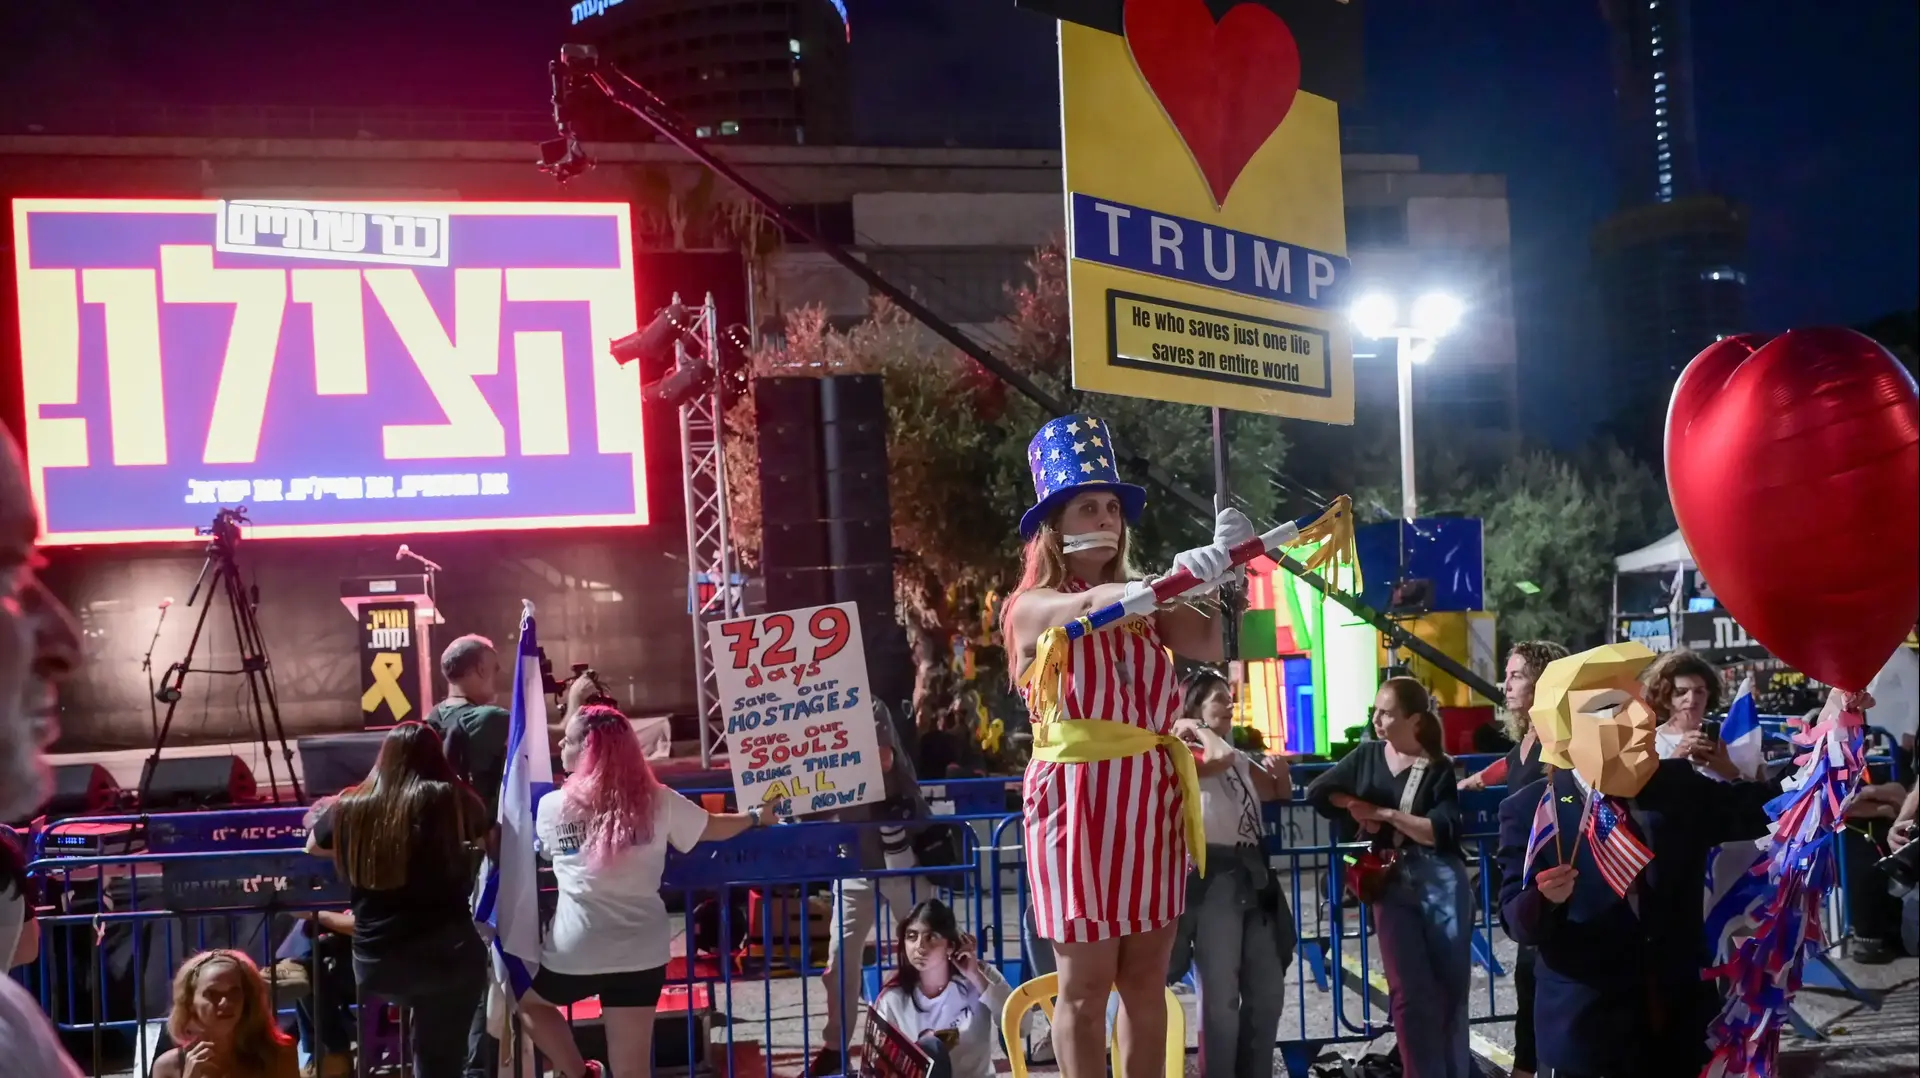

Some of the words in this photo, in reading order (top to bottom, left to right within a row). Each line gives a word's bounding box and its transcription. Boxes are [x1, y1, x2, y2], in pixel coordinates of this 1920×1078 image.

[228, 204, 366, 253] שנתיים
[371, 214, 438, 257] כבר
[1095, 202, 1335, 300] TRUMP
[1132, 306, 1151, 328] He
[1155, 312, 1184, 334] who
[1189, 319, 1230, 342] saves
[1233, 323, 1260, 348] just
[1263, 332, 1287, 352] one
[1291, 334, 1311, 356] life
[25, 244, 642, 467] הצילו!
[1152, 342, 1195, 366] saves
[1199, 350, 1216, 369] an
[1220, 353, 1259, 376] entire
[1262, 361, 1299, 382] world
[721, 607, 850, 669] 729
[745, 660, 821, 689] days
[727, 687, 860, 735] HOSTAGES
[741, 764, 793, 786] BRING
[802, 751, 862, 773] THEM
[748, 730, 849, 769] SOULS
[748, 798, 793, 816] ME
[811, 781, 867, 811] NOW!
[762, 770, 836, 802] ALL
